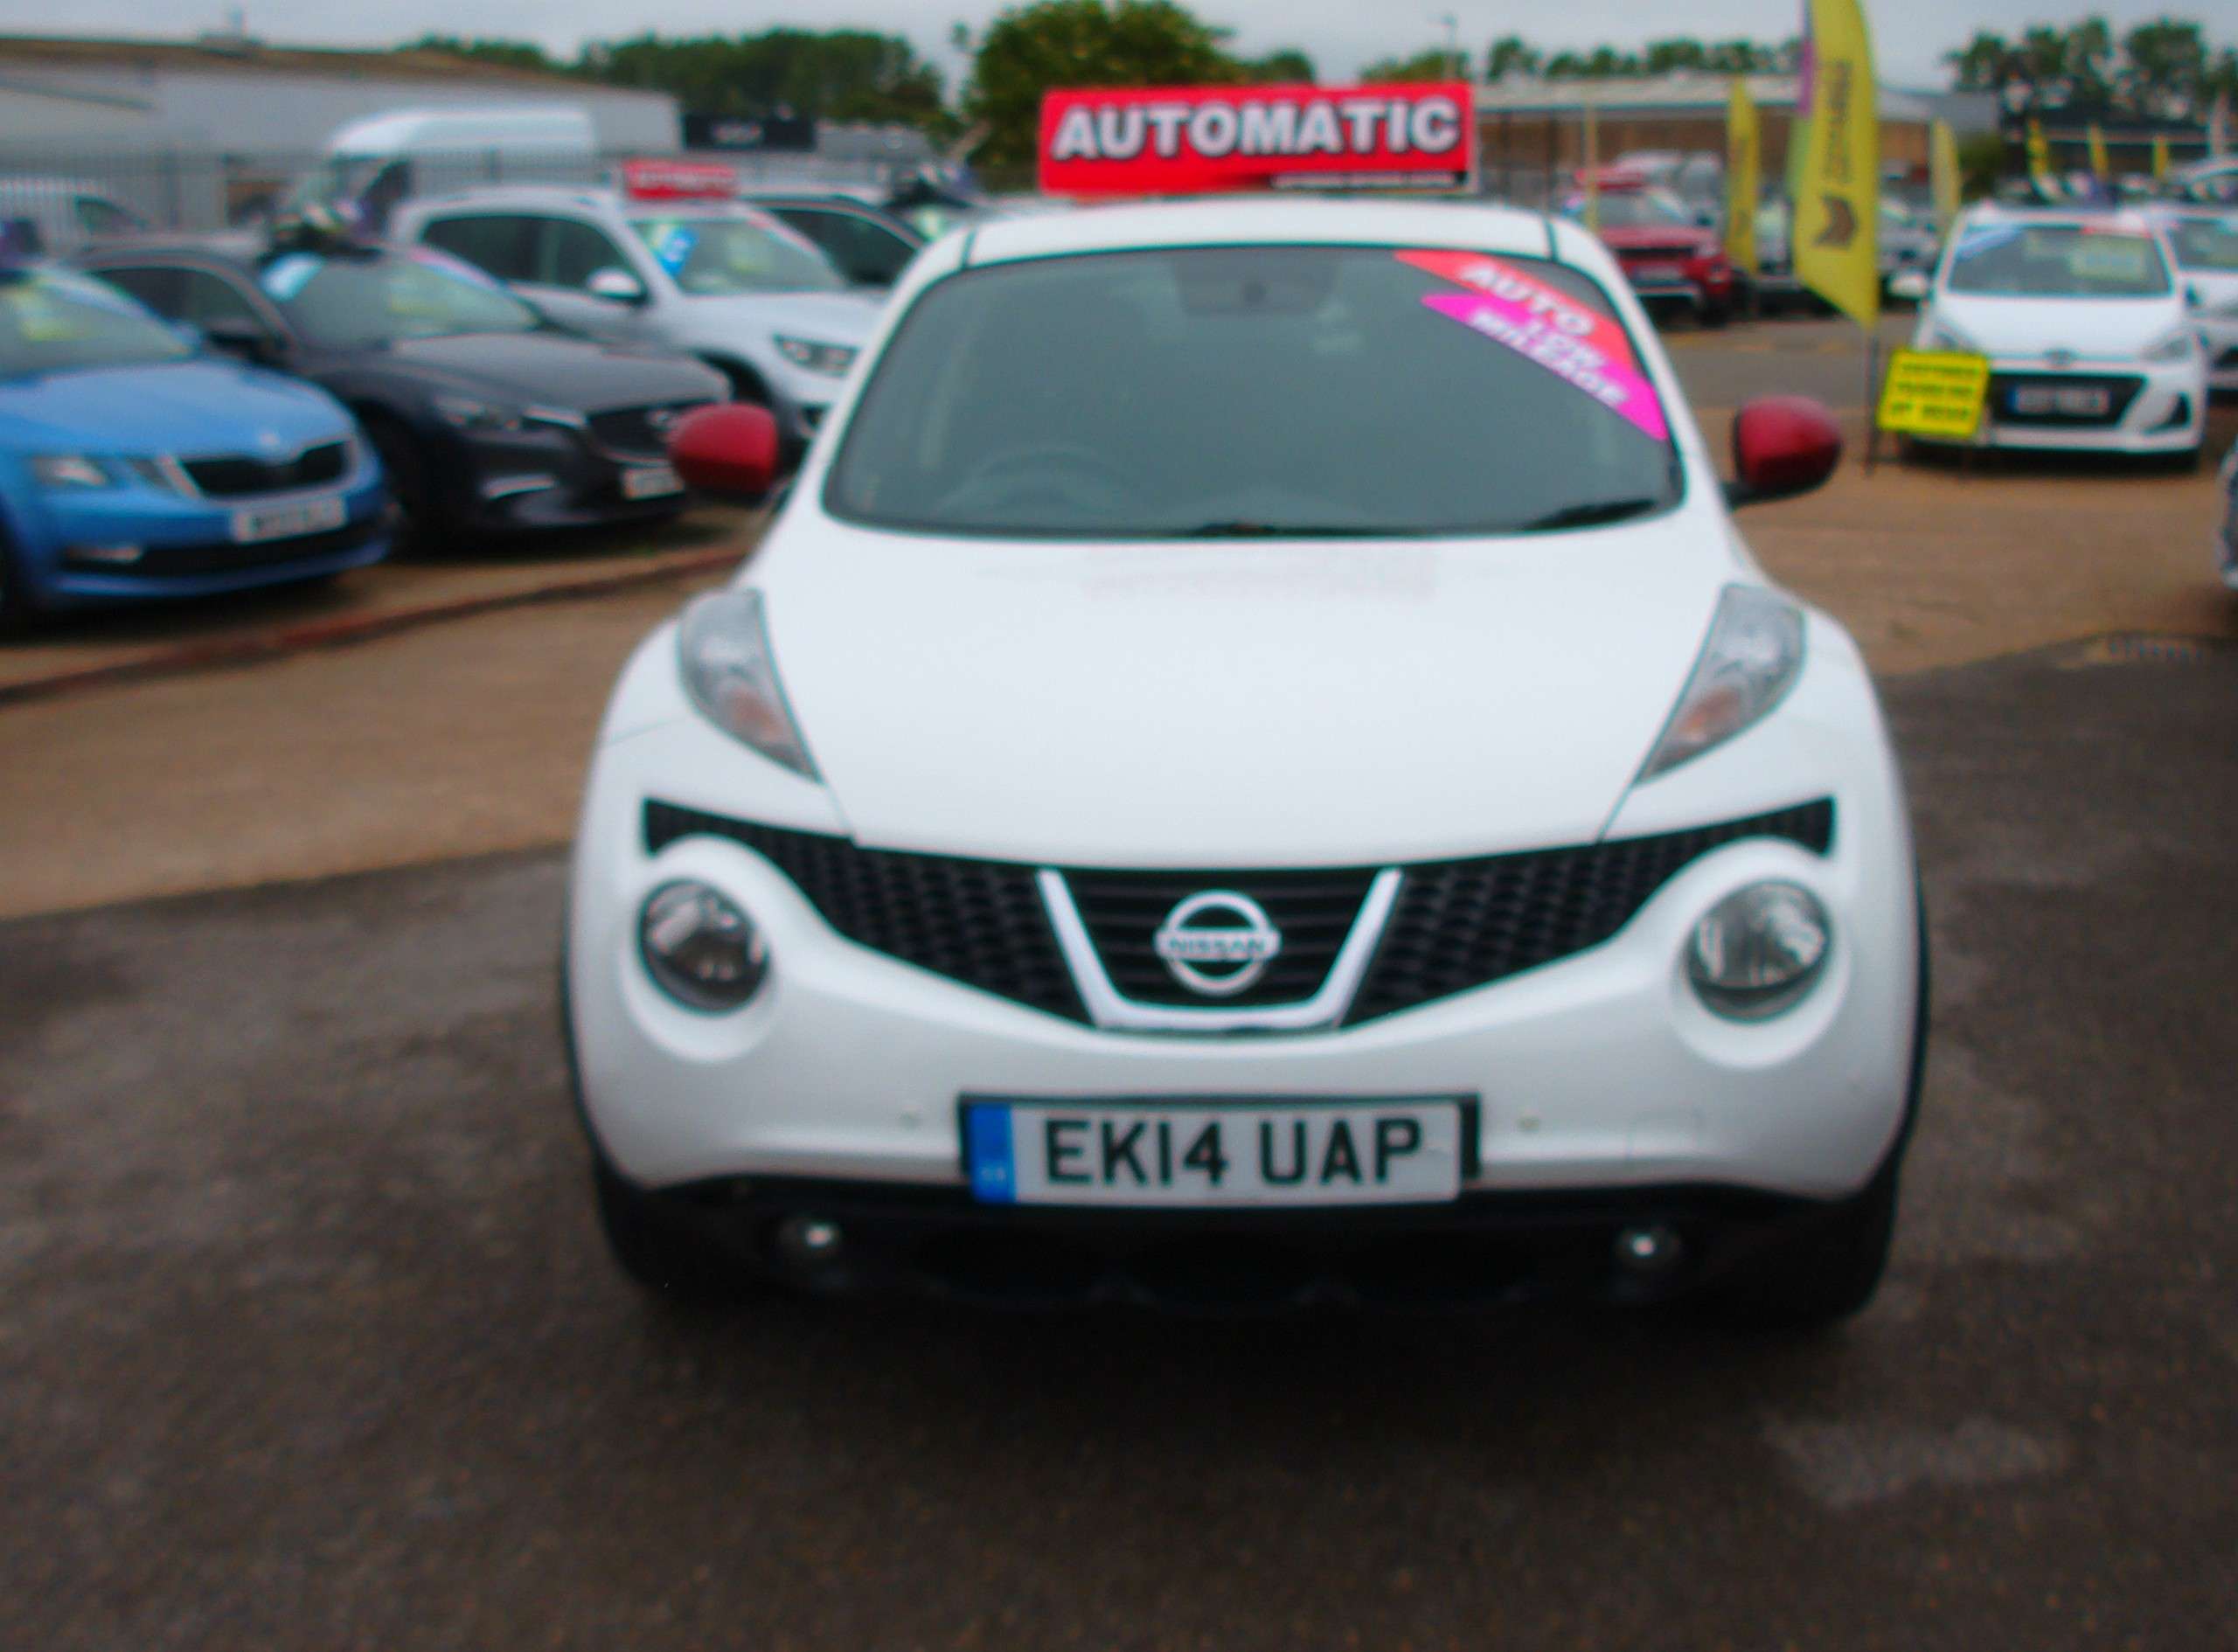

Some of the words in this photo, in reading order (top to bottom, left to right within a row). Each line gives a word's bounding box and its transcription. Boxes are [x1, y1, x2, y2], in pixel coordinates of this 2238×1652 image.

[1051, 96, 1463, 161] AUTOMATIC
[1457, 261, 1596, 337] AUTO
[1169, 936, 1266, 954] NISSAN
[1044, 1120, 1228, 1185] EK14
[1258, 1117, 1422, 1185] UAP
